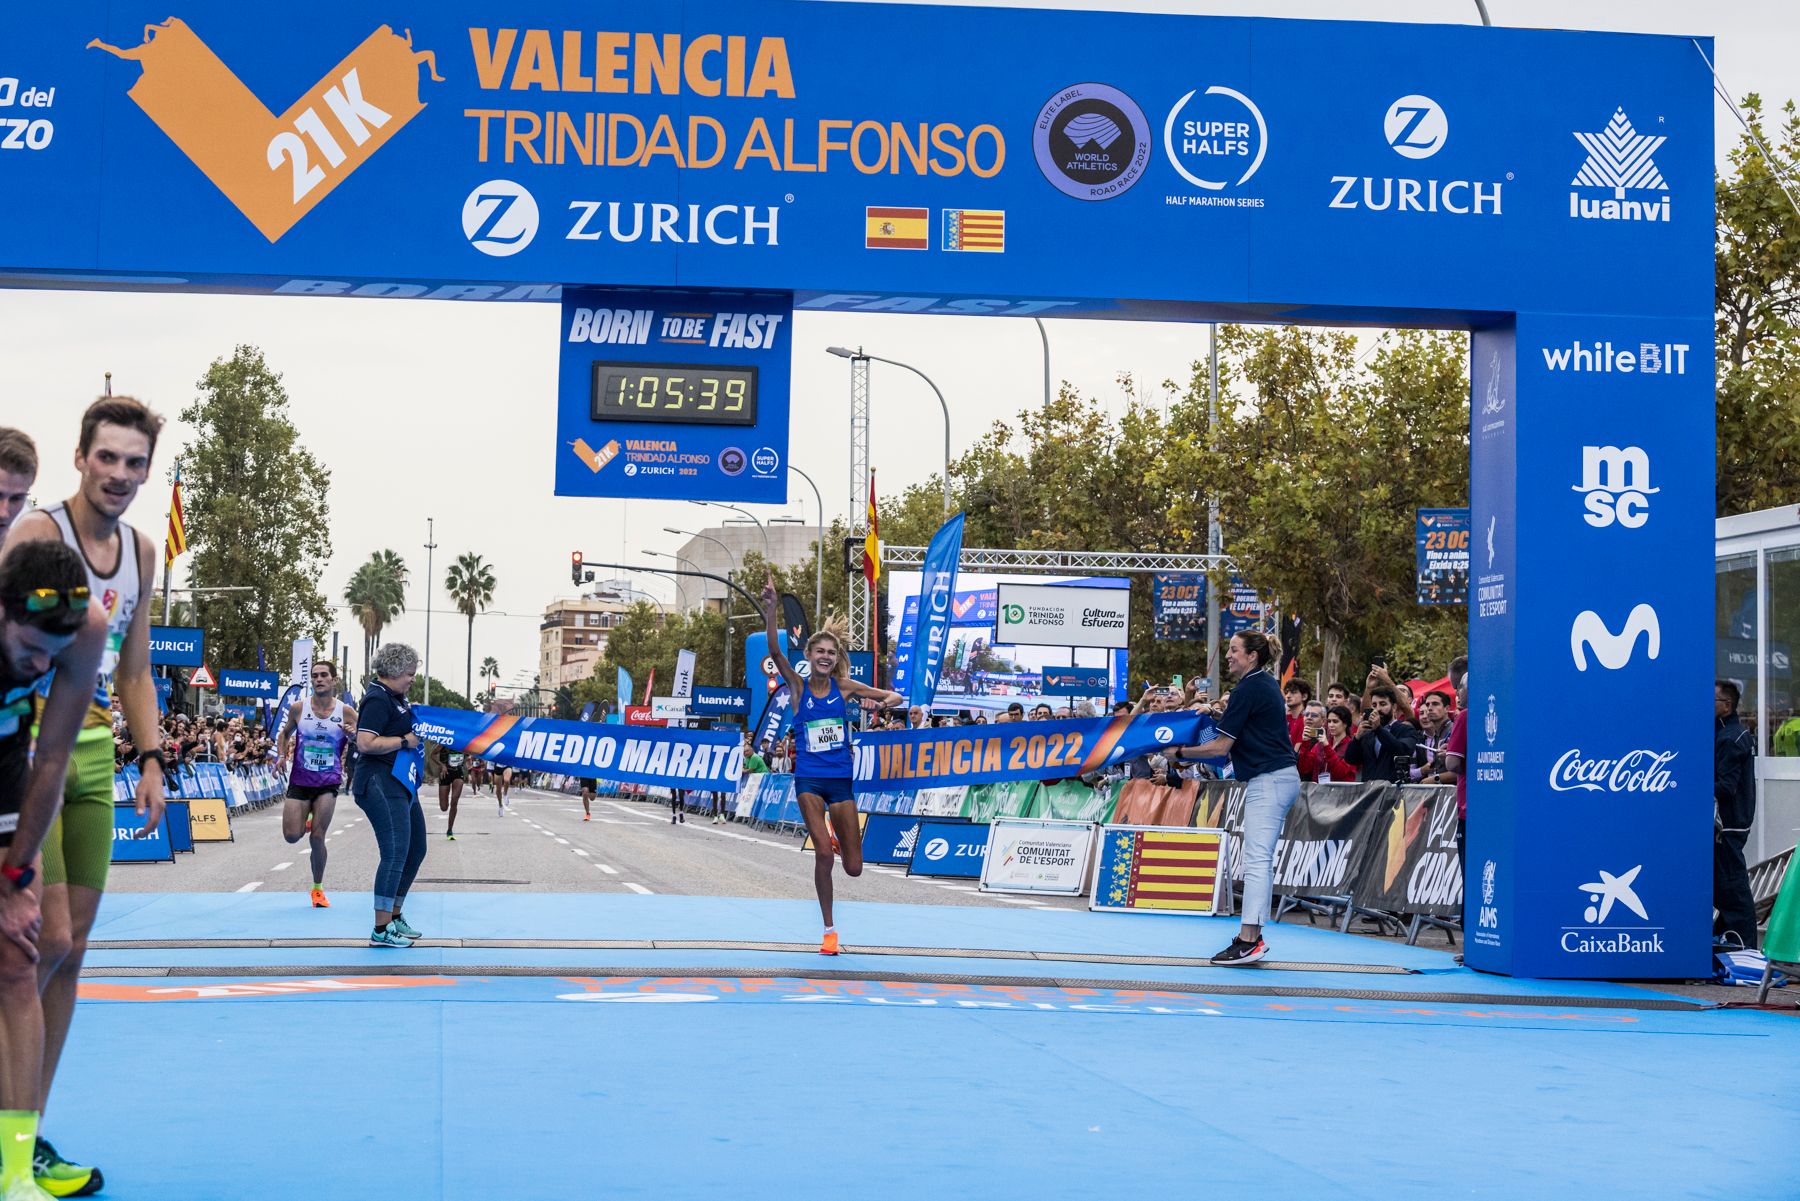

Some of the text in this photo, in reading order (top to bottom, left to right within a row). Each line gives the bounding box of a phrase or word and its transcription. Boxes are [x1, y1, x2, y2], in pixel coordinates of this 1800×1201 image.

[468, 27, 796, 98] VALENCIA
[20, 87, 55, 107] del
[1055, 90, 1082, 107] LABEL
[1040, 106, 1056, 130] ELITE
[266, 67, 392, 205] 21K
[1183, 121, 1249, 138] SUPER
[464, 109, 1006, 178] TRINIDAD ALFONSO
[1183, 139, 1249, 156] HALFS
[1067, 162, 1118, 171] ATHLETICS
[1075, 153, 1109, 162] WORLD
[1090, 142, 1147, 196] ROAD RACE 2022
[1165, 196, 1265, 208] HALF MARATHON SERIES
[1328, 175, 1502, 214] ZURICH
[1570, 192, 1670, 222] luanvi
[566, 200, 779, 245] ZURICH
[568, 308, 783, 349] BORN TO BE FAST
[1542, 341, 1689, 375] whiteBIT
[618, 376, 746, 411] 1:05:39
[625, 440, 677, 452] VALENCIA
[594, 446, 614, 468] 21K
[625, 452, 710, 464] TRINIDAD ALFONSO
[641, 466, 674, 475] ZURICH
[679, 468, 697, 476] 2022
[1425, 531, 1446, 549] 23
[1161, 586, 1176, 599] 23
[1082, 618, 1124, 628] Esfuerzo
[1083, 608, 1116, 619] Cultura
[924, 572, 950, 689] ZURICH
[149, 641, 194, 652] ZURICH
[225, 677, 260, 688] luanvi
[698, 694, 732, 706] luanvi
[514, 730, 617, 769] MEDIO
[879, 738, 1001, 780] VALENCIA
[1008, 731, 1082, 771] 2022
[1550, 748, 1679, 792] Coca-Cola
[1017, 847, 1070, 857] COMUNITAT
[1020, 856, 1075, 866] DE L'ESPORT
[1479, 907, 1497, 928] AIMS
[1560, 932, 1665, 953] CaixaBank
